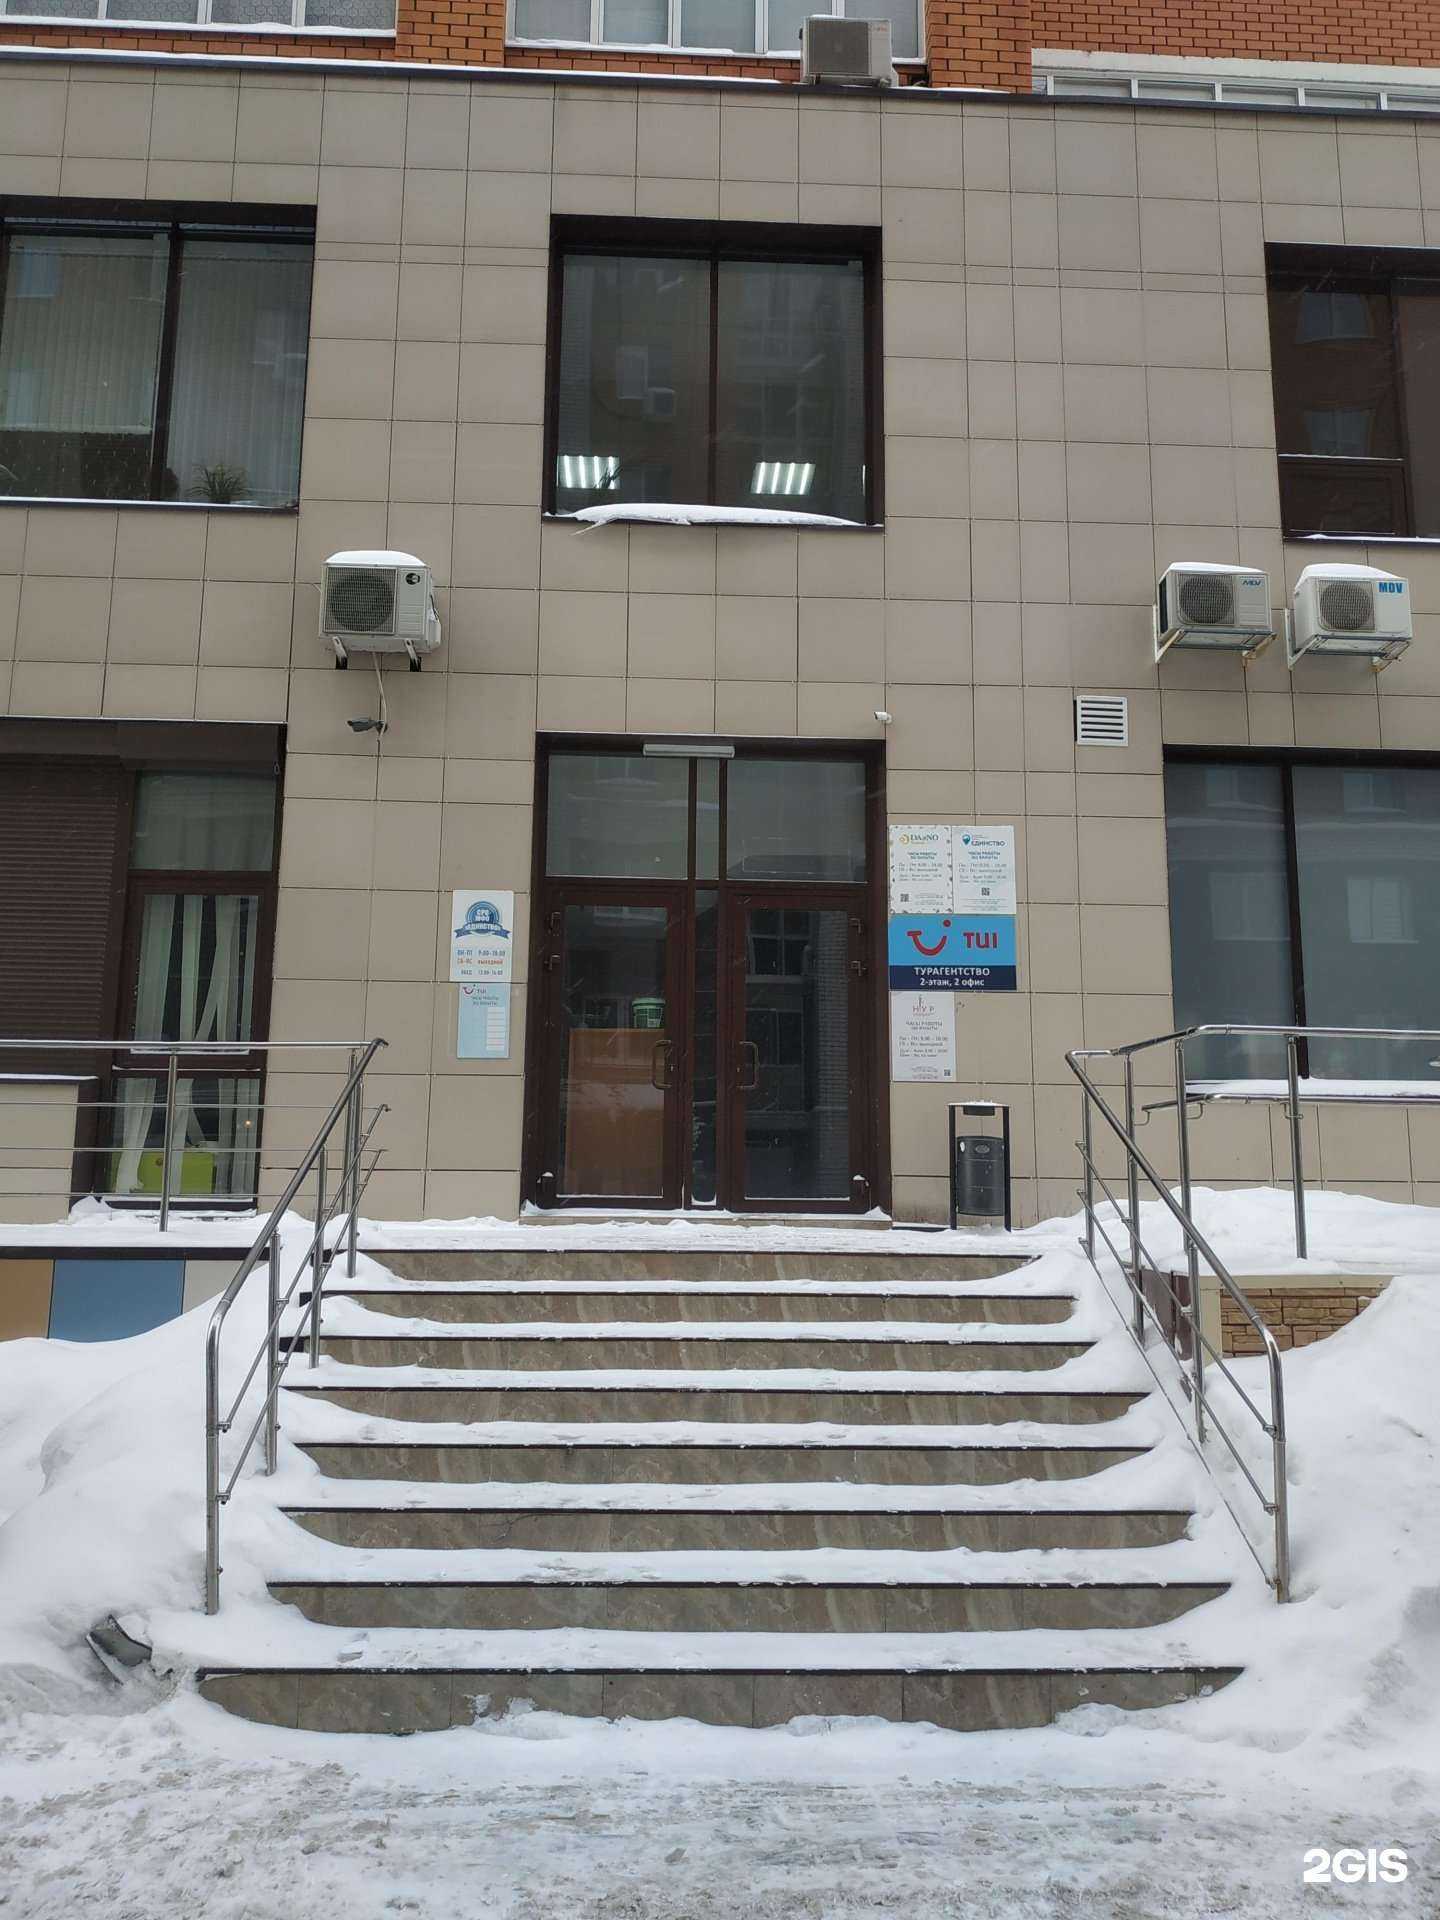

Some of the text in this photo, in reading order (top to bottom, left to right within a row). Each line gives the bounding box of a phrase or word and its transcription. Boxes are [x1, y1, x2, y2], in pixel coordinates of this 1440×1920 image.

[1378, 582, 1403, 593] MDV
[963, 932, 998, 949] TUI
[914, 967, 990, 976] ТУРАГЕНТСТВО
[919, 977, 985, 988] 2-этаж, 2 офис
